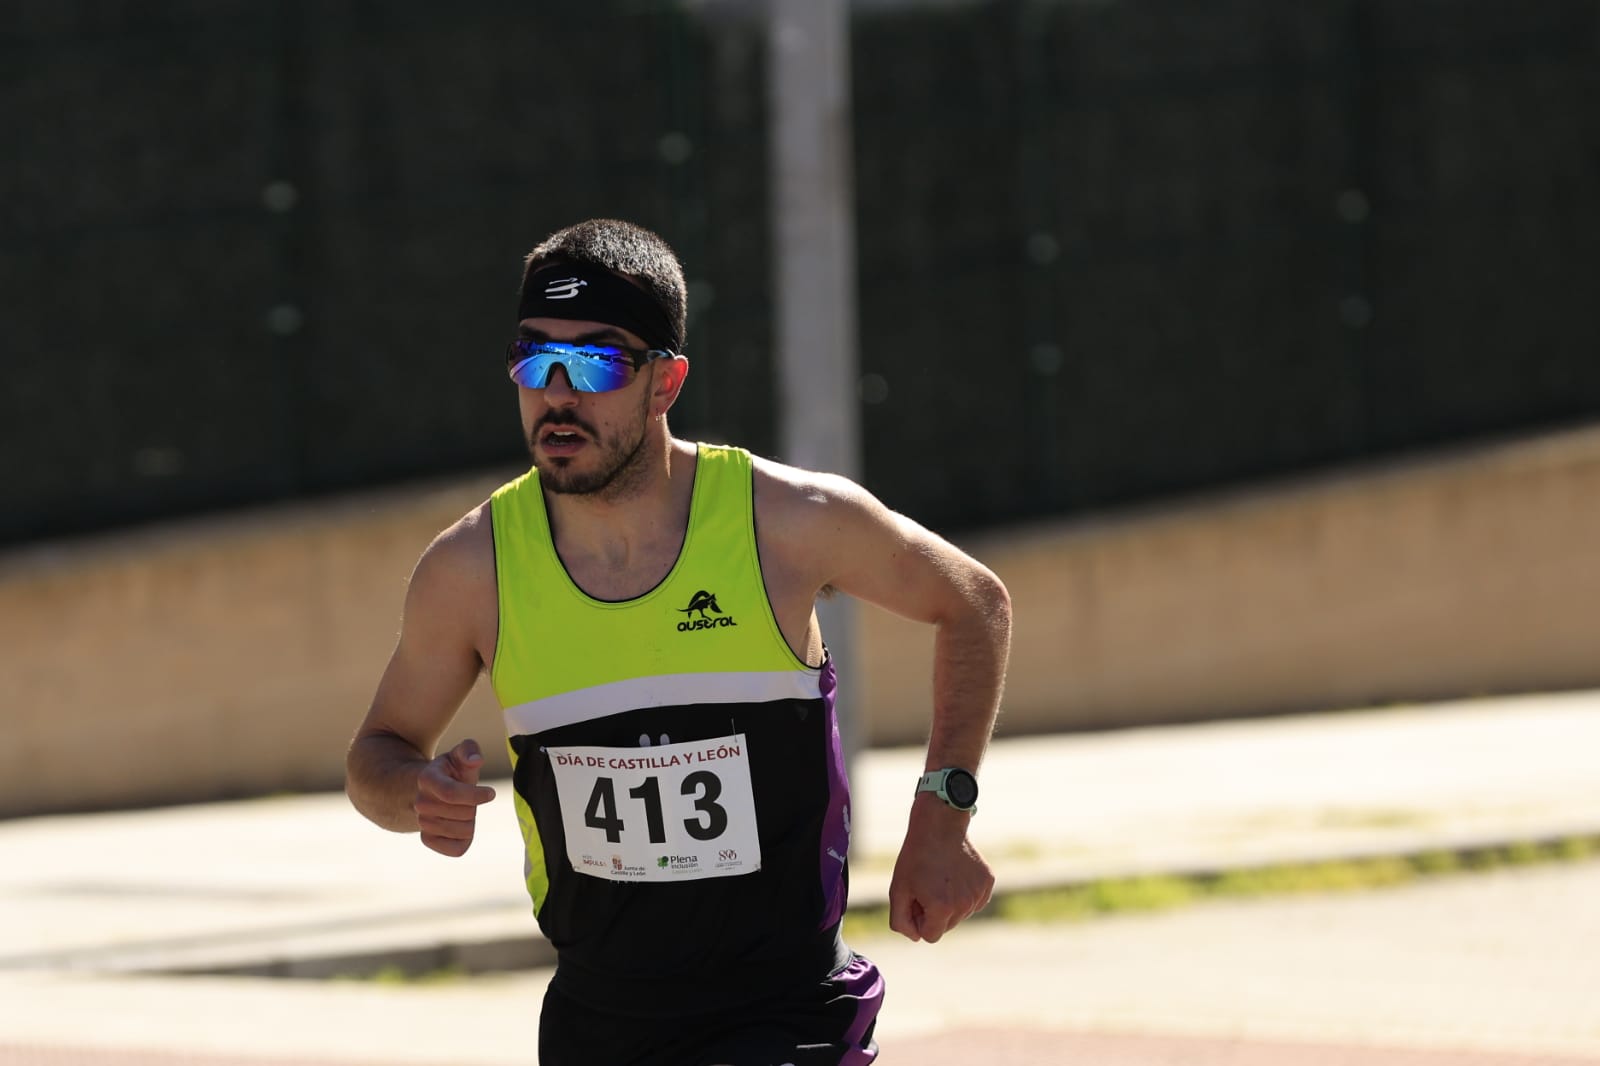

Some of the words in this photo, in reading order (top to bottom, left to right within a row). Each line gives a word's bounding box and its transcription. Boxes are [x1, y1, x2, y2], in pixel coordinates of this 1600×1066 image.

[557, 753, 584, 766] DÍA
[586, 756, 606, 769] DE
[608, 755, 681, 769] CASTILLA
[683, 752, 693, 764] Y
[697, 745, 741, 762] LEÓN
[584, 770, 728, 844] 413
[670, 855, 698, 864] Plena
